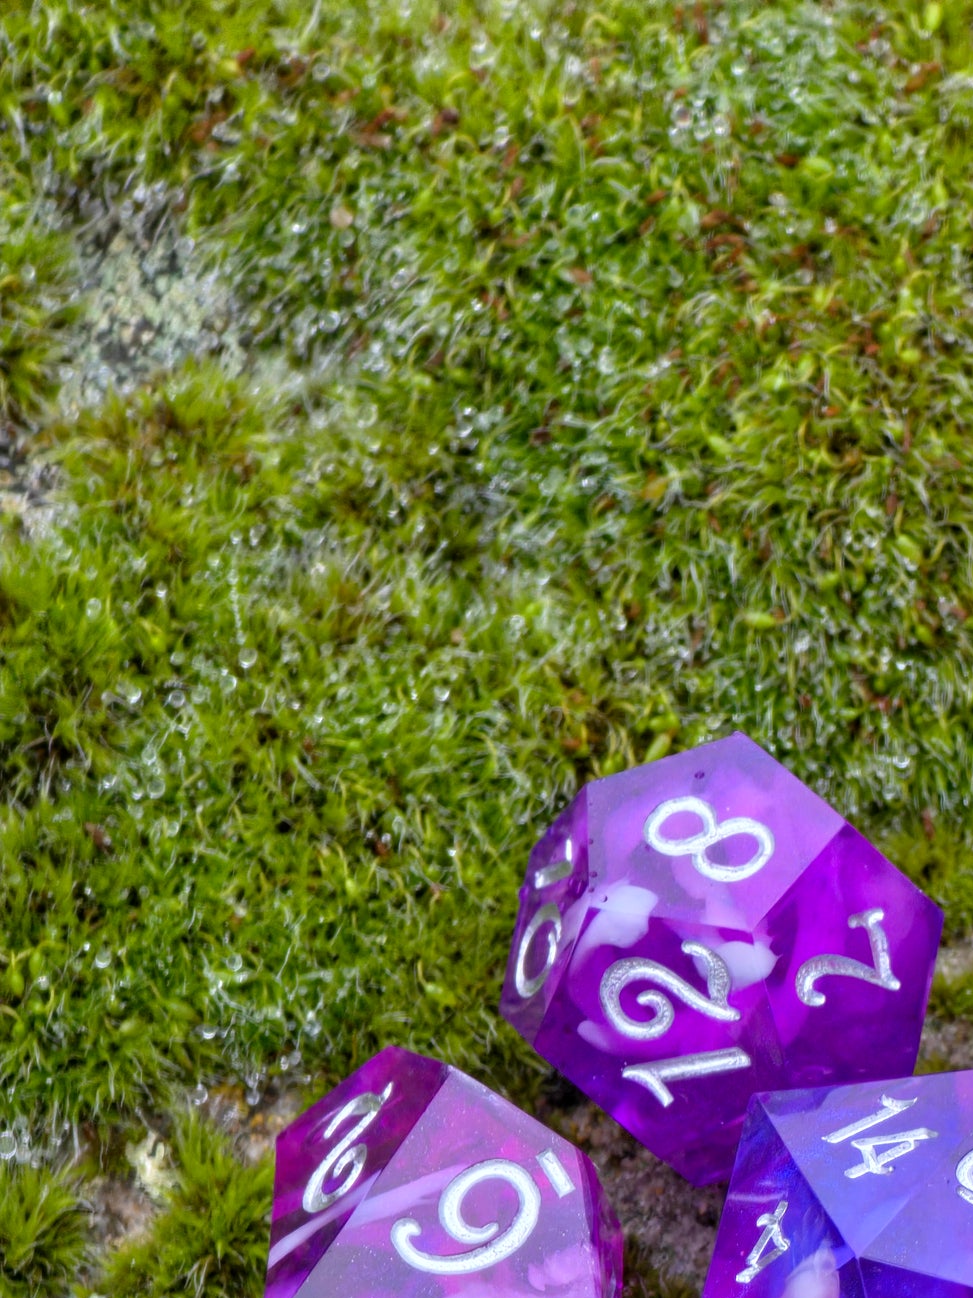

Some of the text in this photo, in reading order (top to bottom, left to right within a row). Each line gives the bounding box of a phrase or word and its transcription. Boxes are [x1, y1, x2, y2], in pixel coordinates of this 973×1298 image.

[644, 797, 774, 882] 8
[600, 941, 751, 1107] 12
[822, 1094, 938, 1179] 14
[736, 1201, 790, 1283] 4
